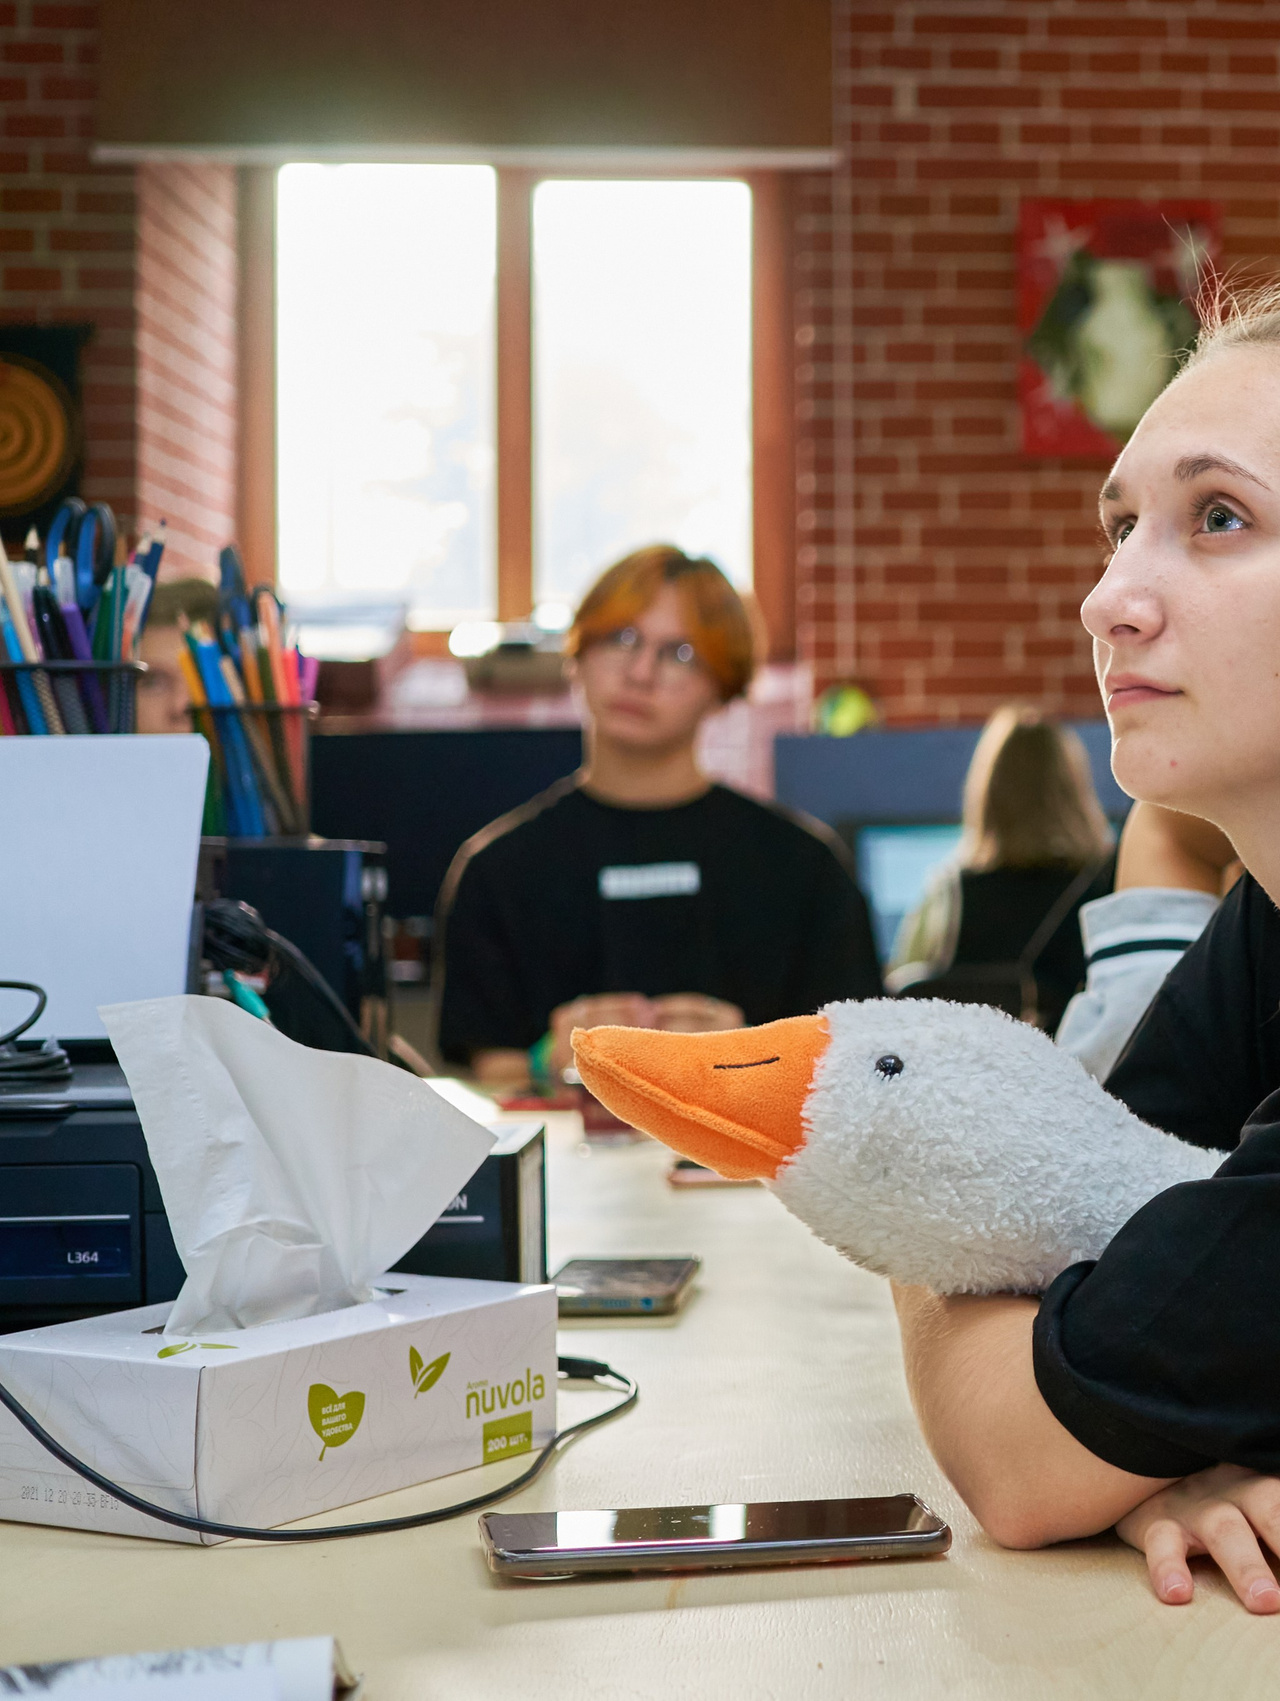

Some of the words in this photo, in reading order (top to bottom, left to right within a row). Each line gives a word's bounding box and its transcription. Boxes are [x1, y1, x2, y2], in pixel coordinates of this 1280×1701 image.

[67, 1251, 99, 1264] L364
[466, 1367, 545, 1419] nuvola
[321, 1413, 347, 1426] ВАШЕГО
[321, 1422, 354, 1437] УДОБСТВА
[487, 1435, 508, 1453] 200
[21, 1485, 39, 1501] 2021
[44, 1487, 54, 1502] 12
